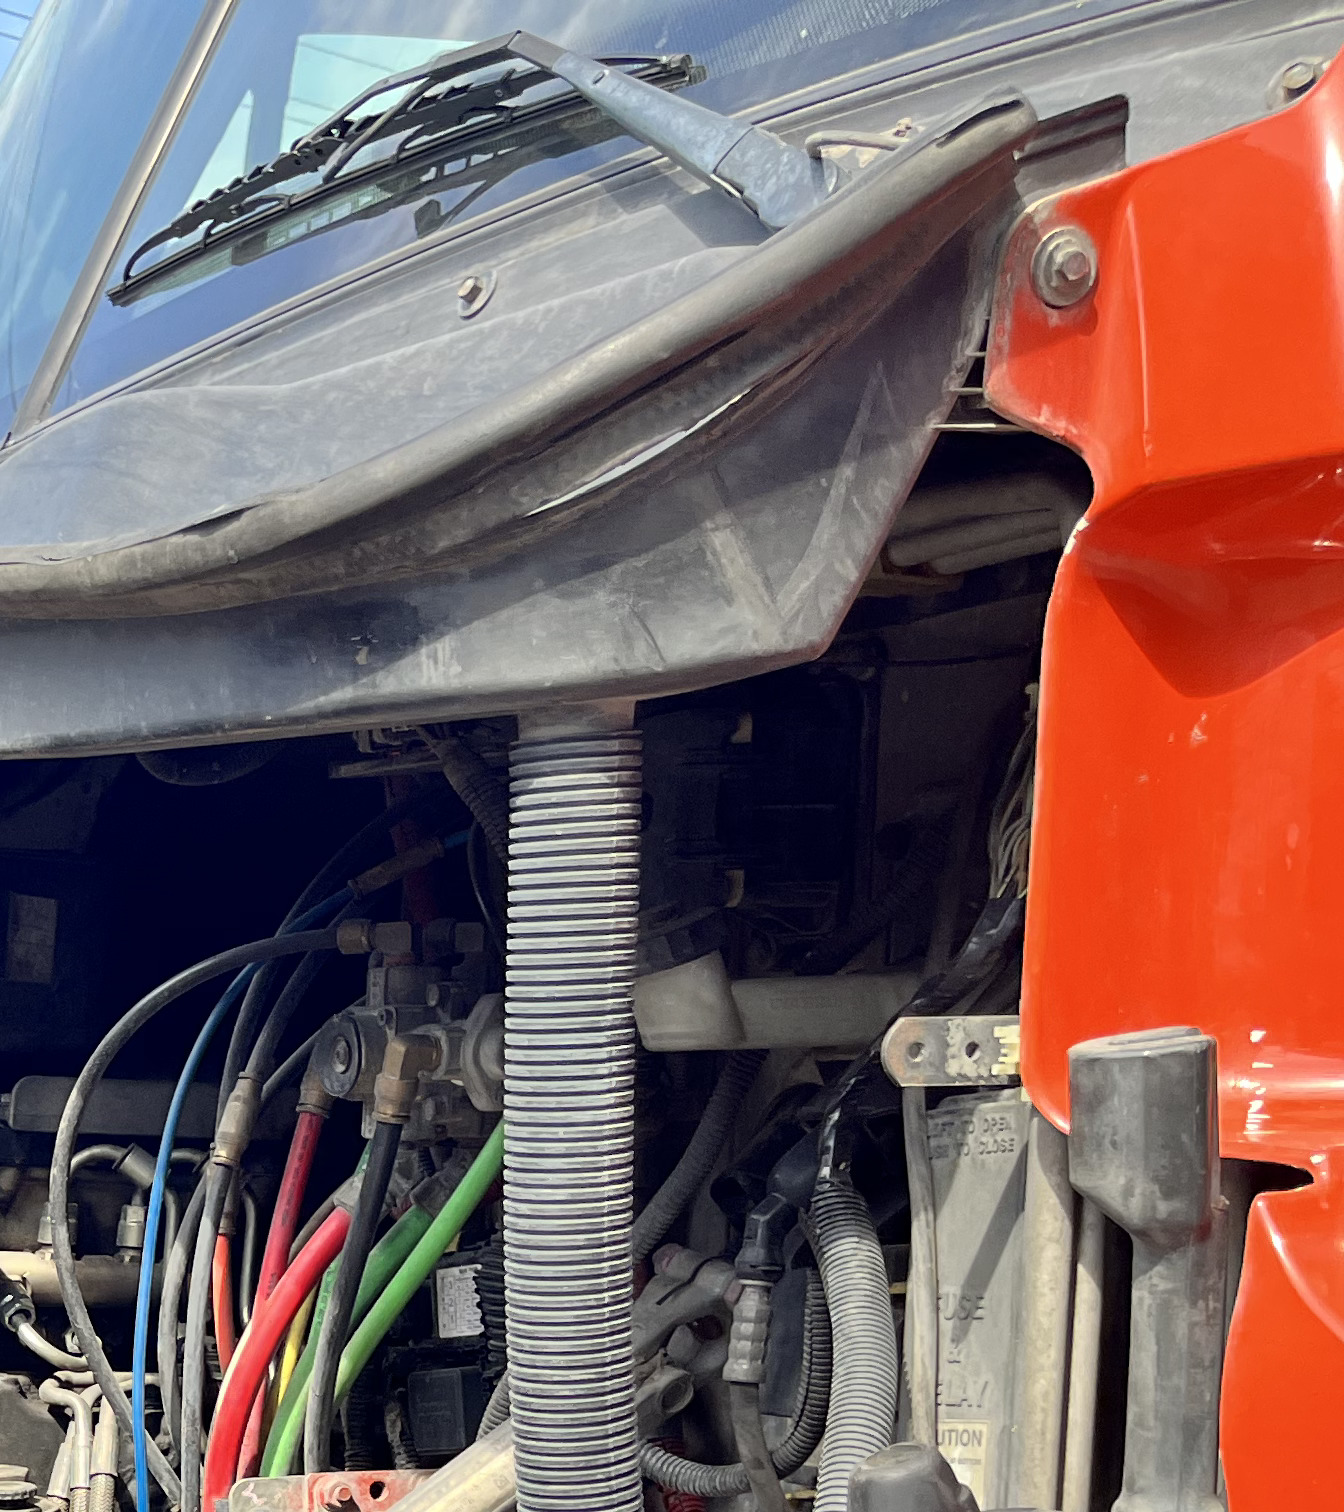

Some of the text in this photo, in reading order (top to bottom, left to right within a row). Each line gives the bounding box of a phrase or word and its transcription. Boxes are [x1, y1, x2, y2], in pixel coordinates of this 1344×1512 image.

[979, 1137, 1015, 1155] CLOSE
[938, 1294, 986, 1321] USE
[936, 1428, 983, 1447] UTION
